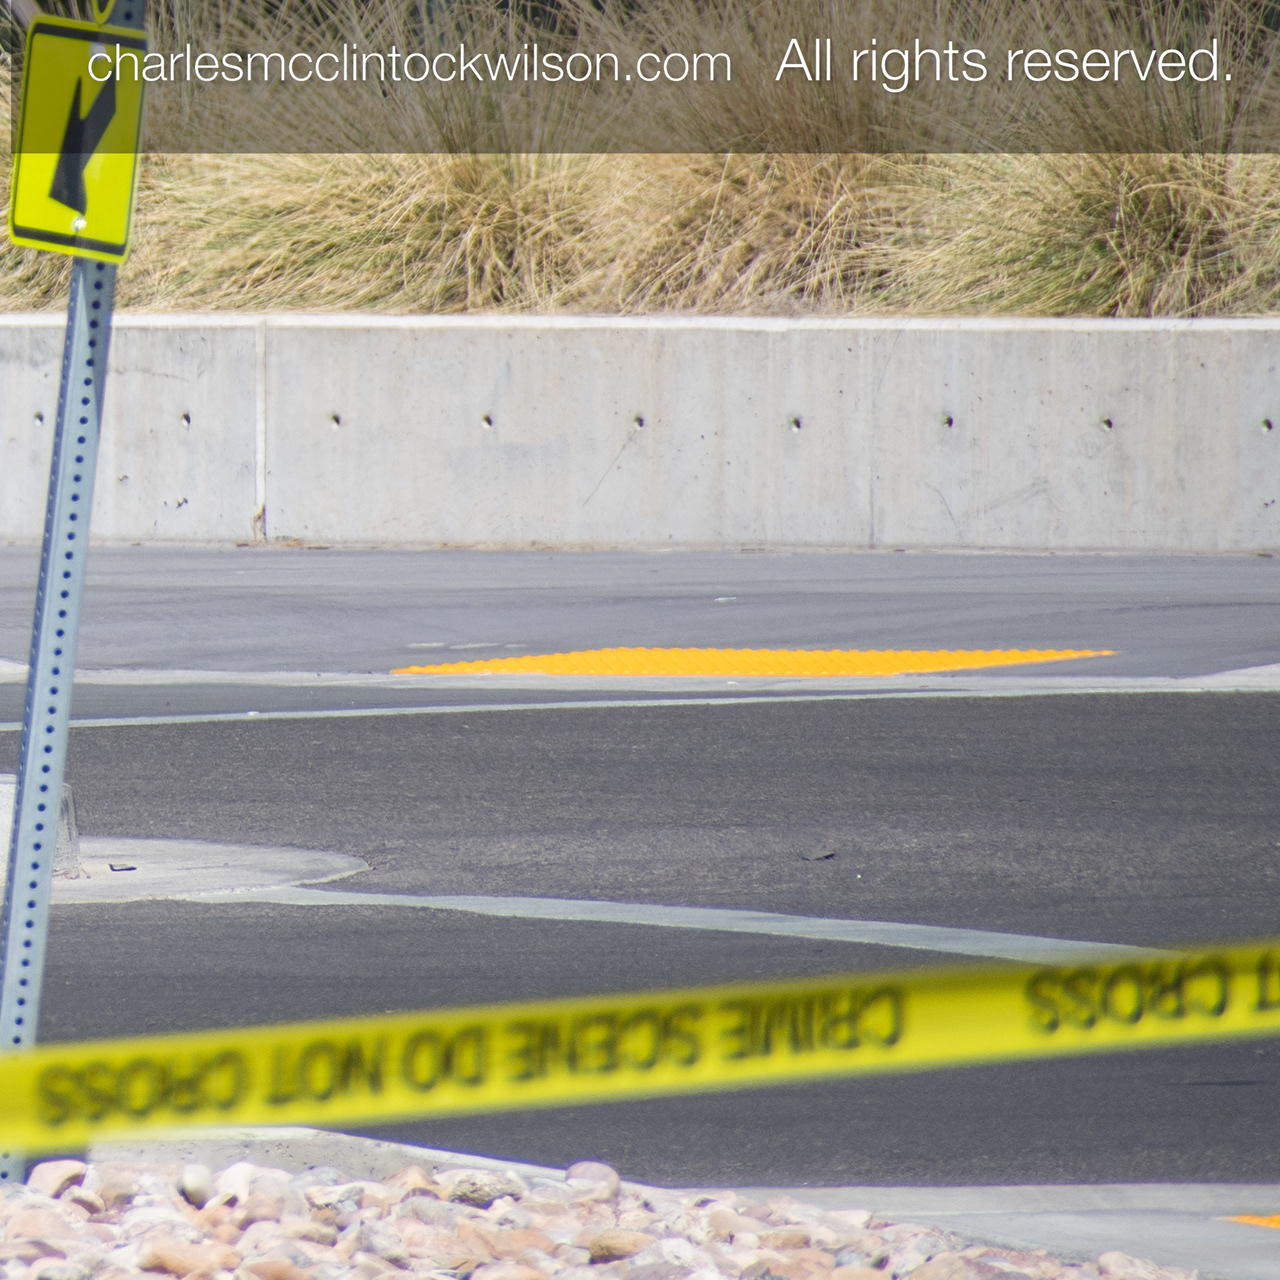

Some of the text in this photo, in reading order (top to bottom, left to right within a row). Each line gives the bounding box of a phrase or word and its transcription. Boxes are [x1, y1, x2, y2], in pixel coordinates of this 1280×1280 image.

[1026, 954, 1228, 1034] CROSS
[34, 984, 907, 1128] CRIME SCENE DO NOT CROSS
